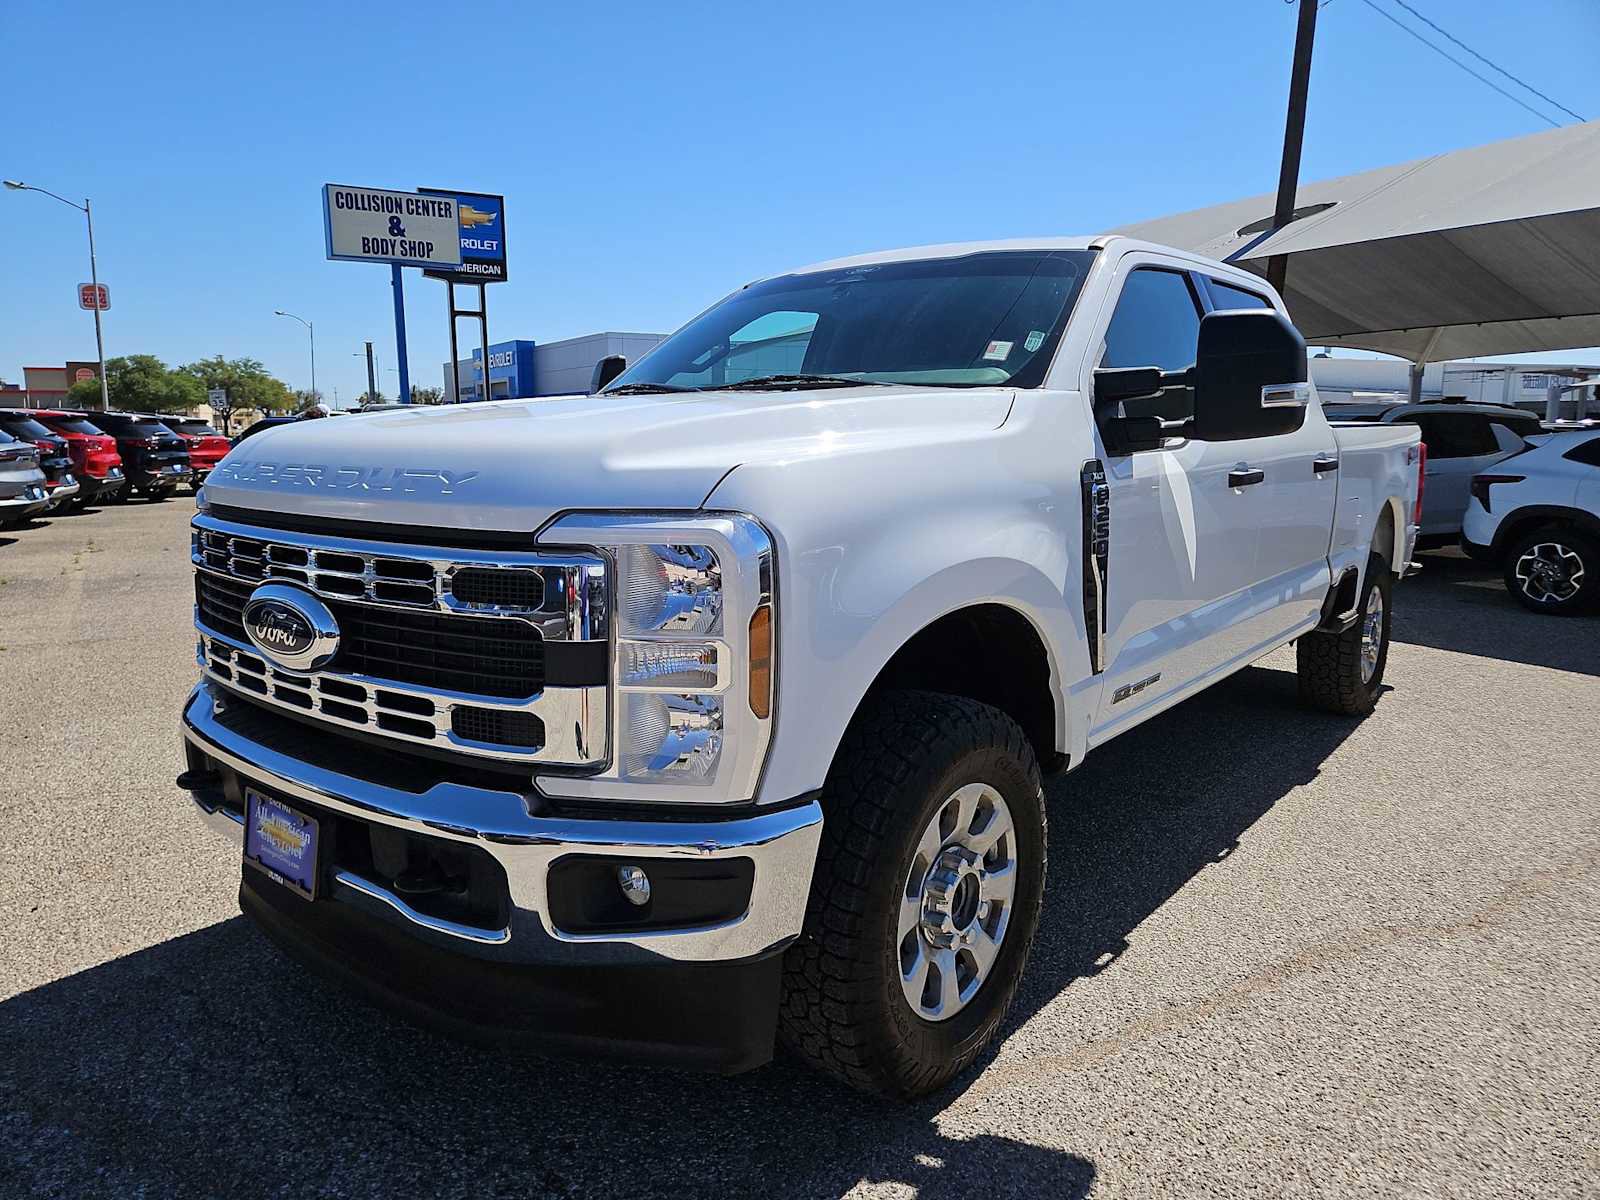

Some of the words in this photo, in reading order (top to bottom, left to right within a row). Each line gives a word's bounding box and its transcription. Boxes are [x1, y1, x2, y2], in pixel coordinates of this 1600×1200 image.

[335, 191, 403, 214] COLLISION
[406, 195, 452, 218] CENTER
[388, 216, 406, 237] &
[362, 237, 396, 255] BODY
[400, 240, 434, 258] SHOP
[212, 399, 225, 407] 35
[222, 461, 328, 487] SUPER
[328, 467, 480, 495] DUTY
[1092, 472, 1104, 480] XLT
[256, 608, 297, 647] Ford
